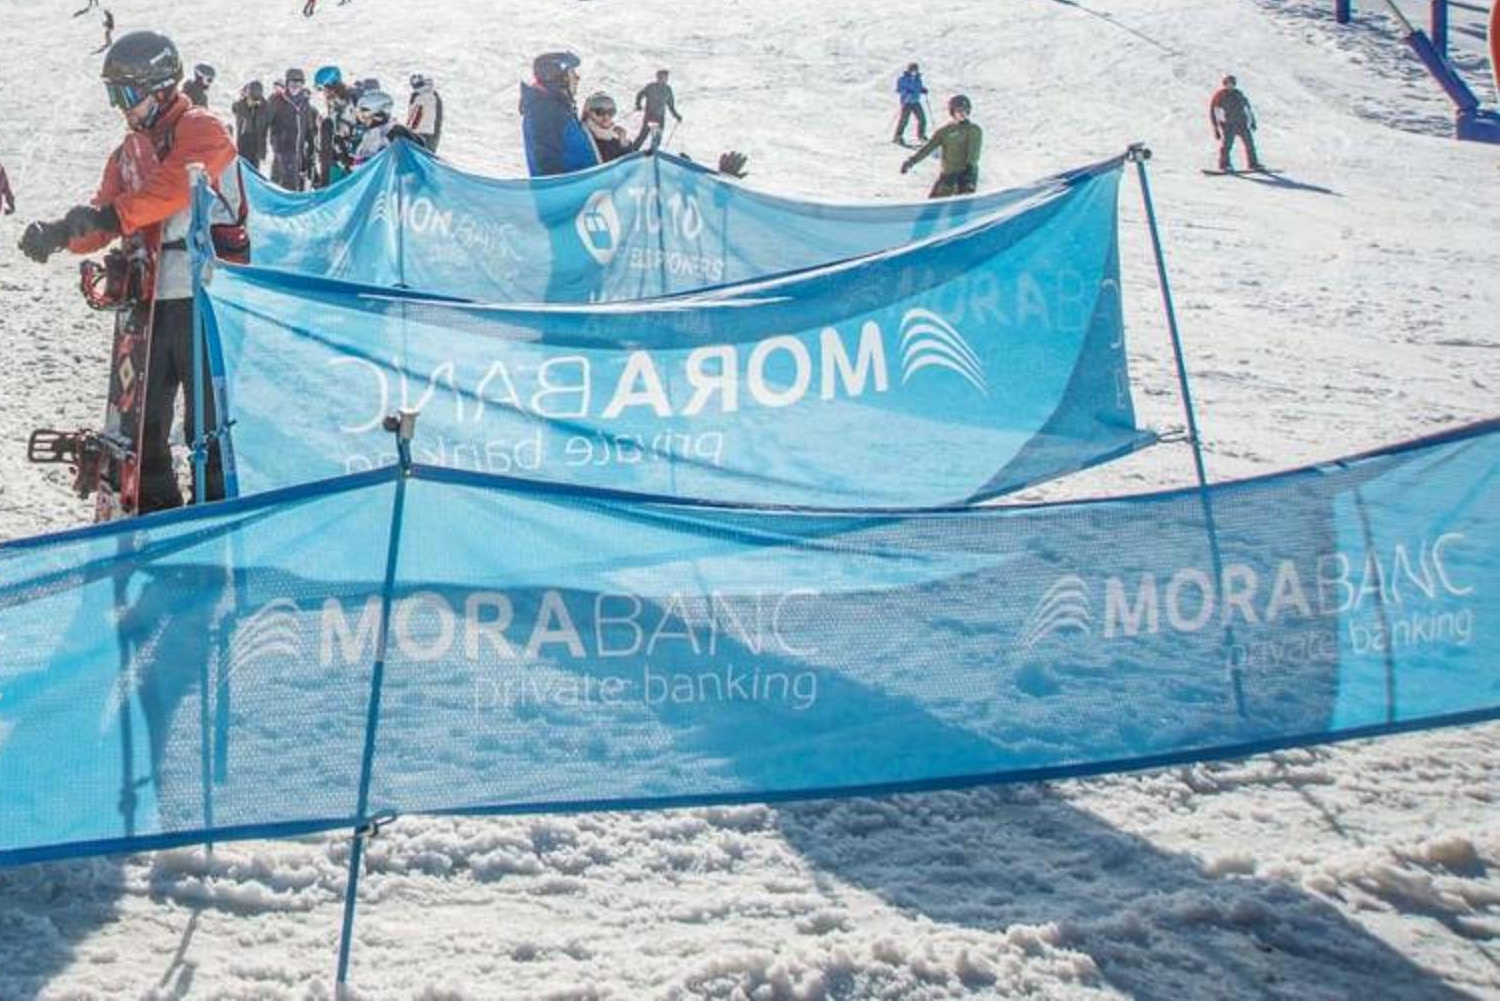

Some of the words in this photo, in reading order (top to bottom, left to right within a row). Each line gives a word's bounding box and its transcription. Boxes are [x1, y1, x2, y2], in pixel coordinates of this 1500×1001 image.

[1104, 531, 1475, 638] MORABANC
[318, 589, 819, 667] MORABANC
[1350, 608, 1475, 656] banking
[474, 667, 626, 712] private
[644, 662, 819, 710] banking
